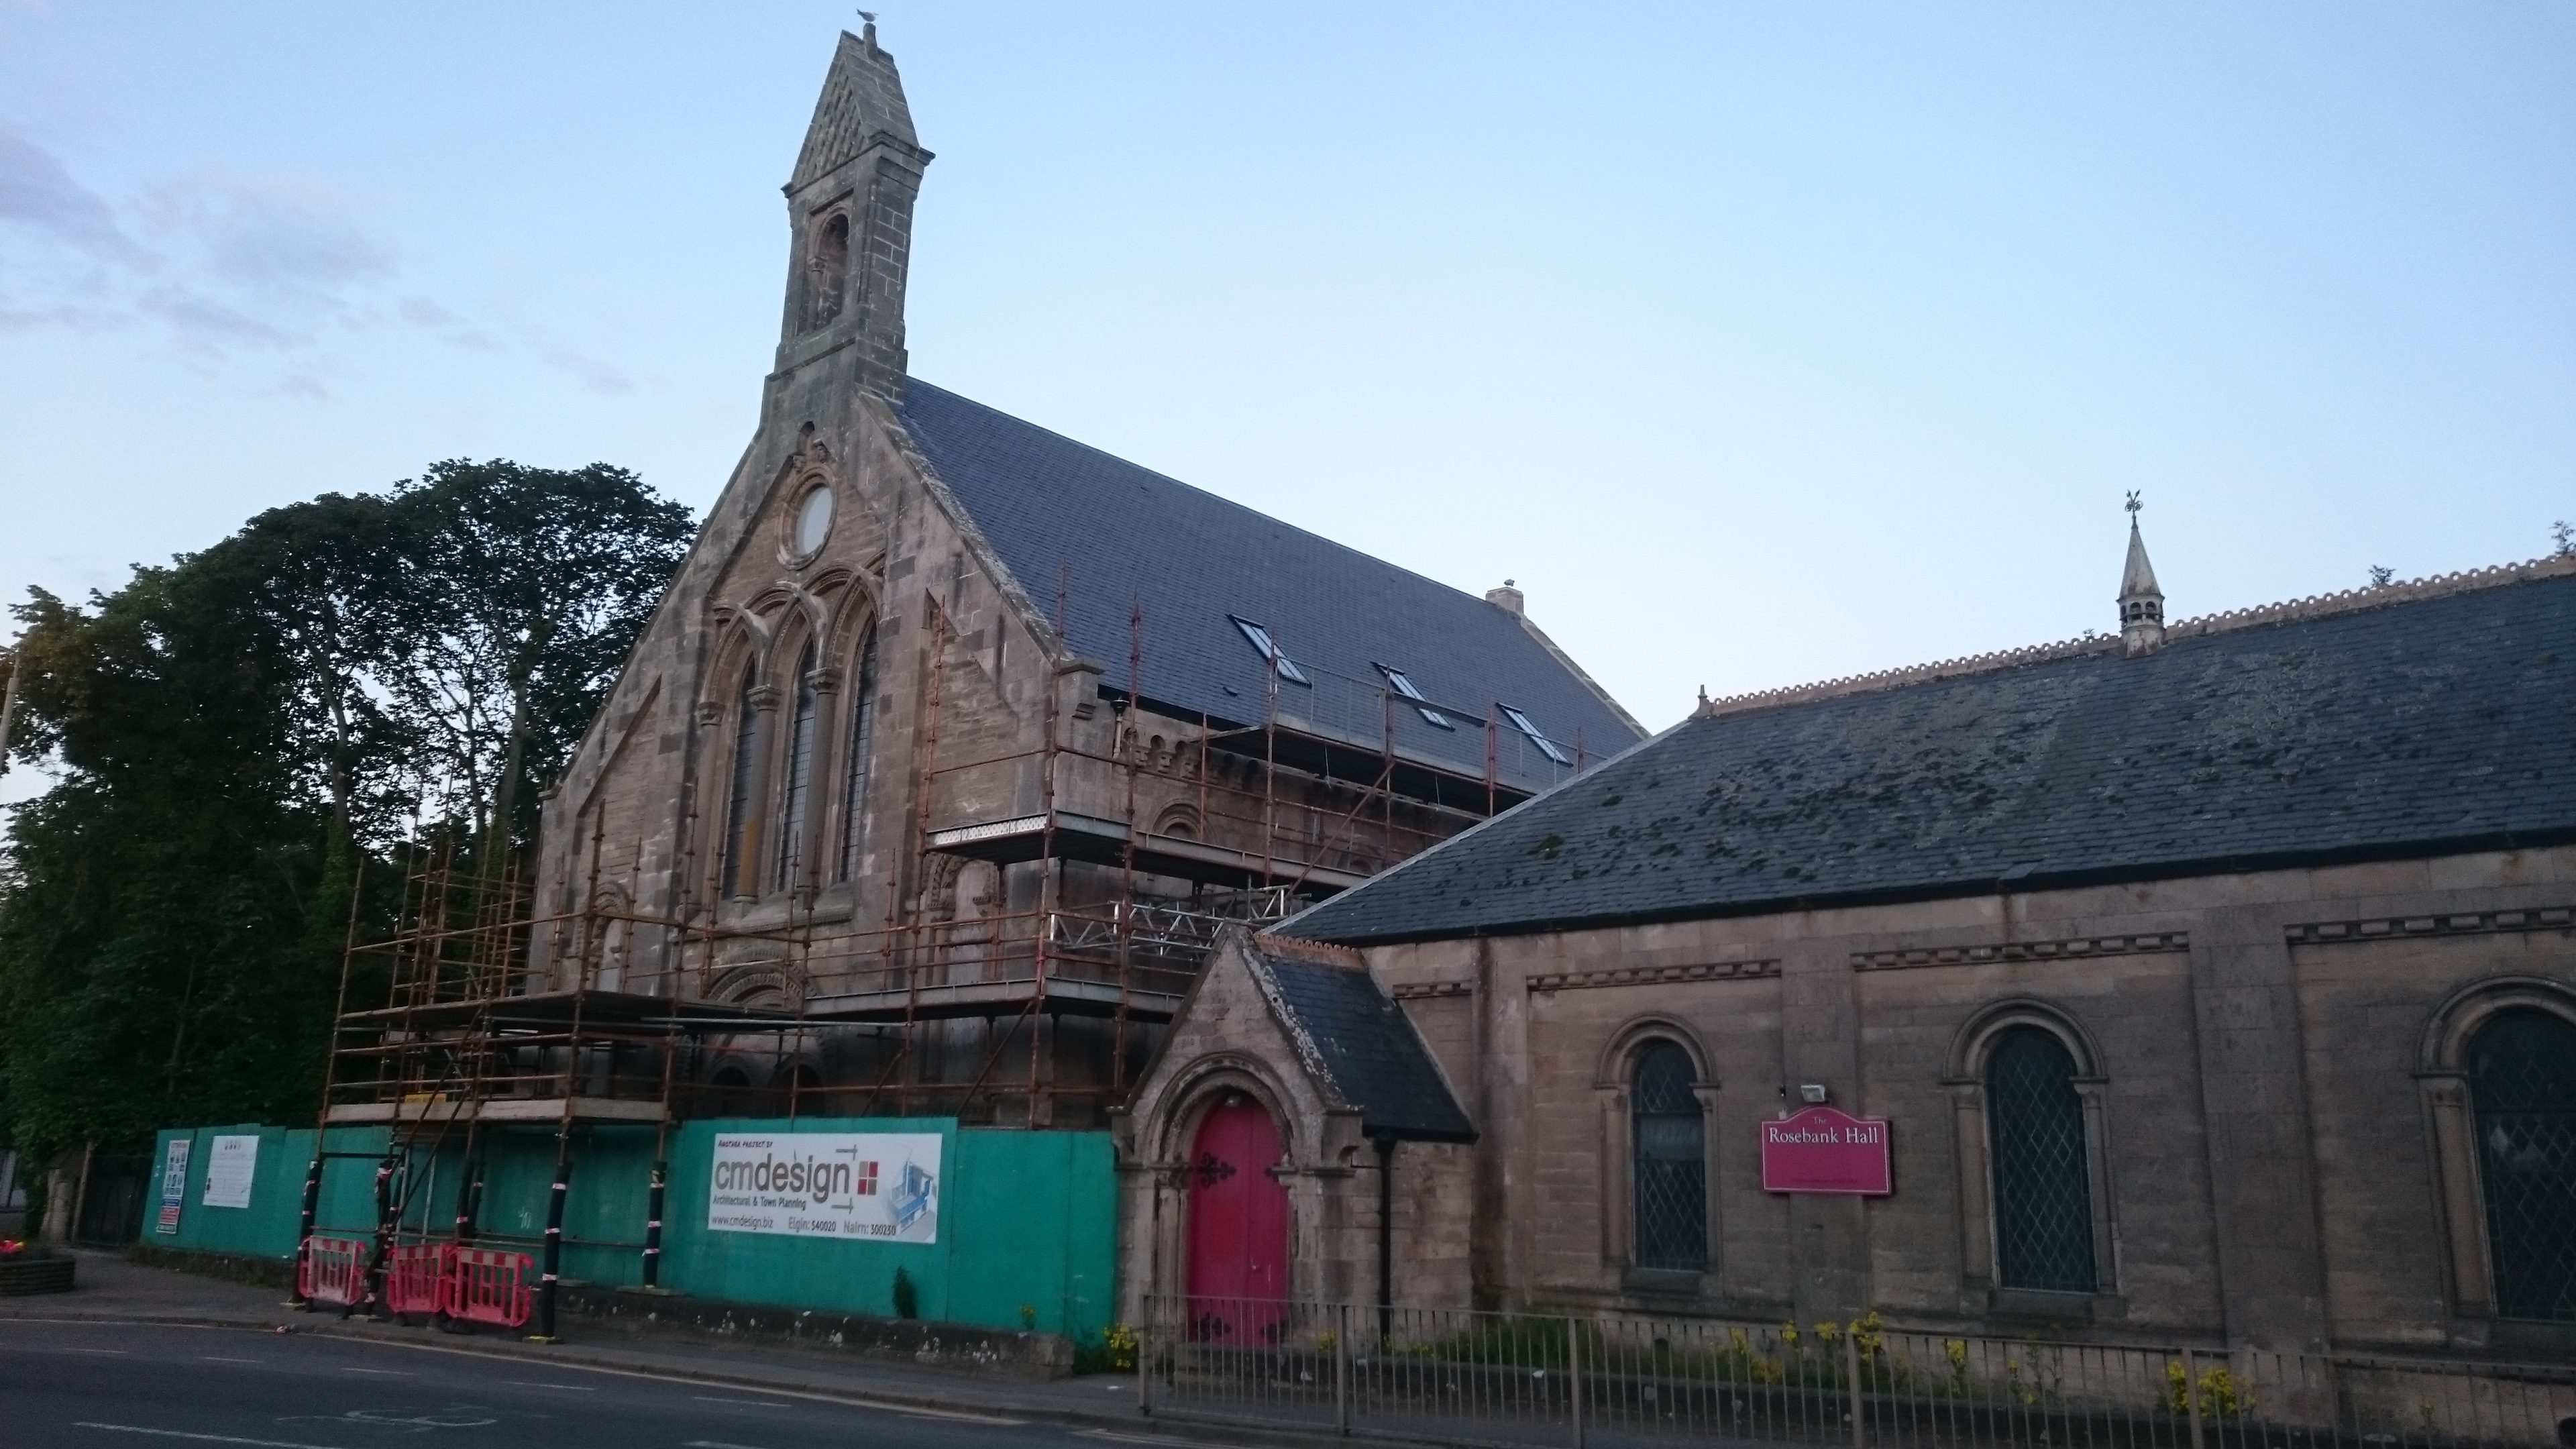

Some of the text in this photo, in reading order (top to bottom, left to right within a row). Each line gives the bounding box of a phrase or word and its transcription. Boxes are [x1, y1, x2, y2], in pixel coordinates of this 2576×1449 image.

[1813, 1116, 1827, 1124] The
[1768, 1126, 1878, 1144] Rosebank Hall
[715, 1152, 850, 1203] cmdesign
[713, 1195, 806, 1210] Architectural & Town Planning
[712, 1215, 773, 1230] www.cmdesign.biz
[788, 1216, 896, 1236] Elgin: 540020 Nairn: 300230
